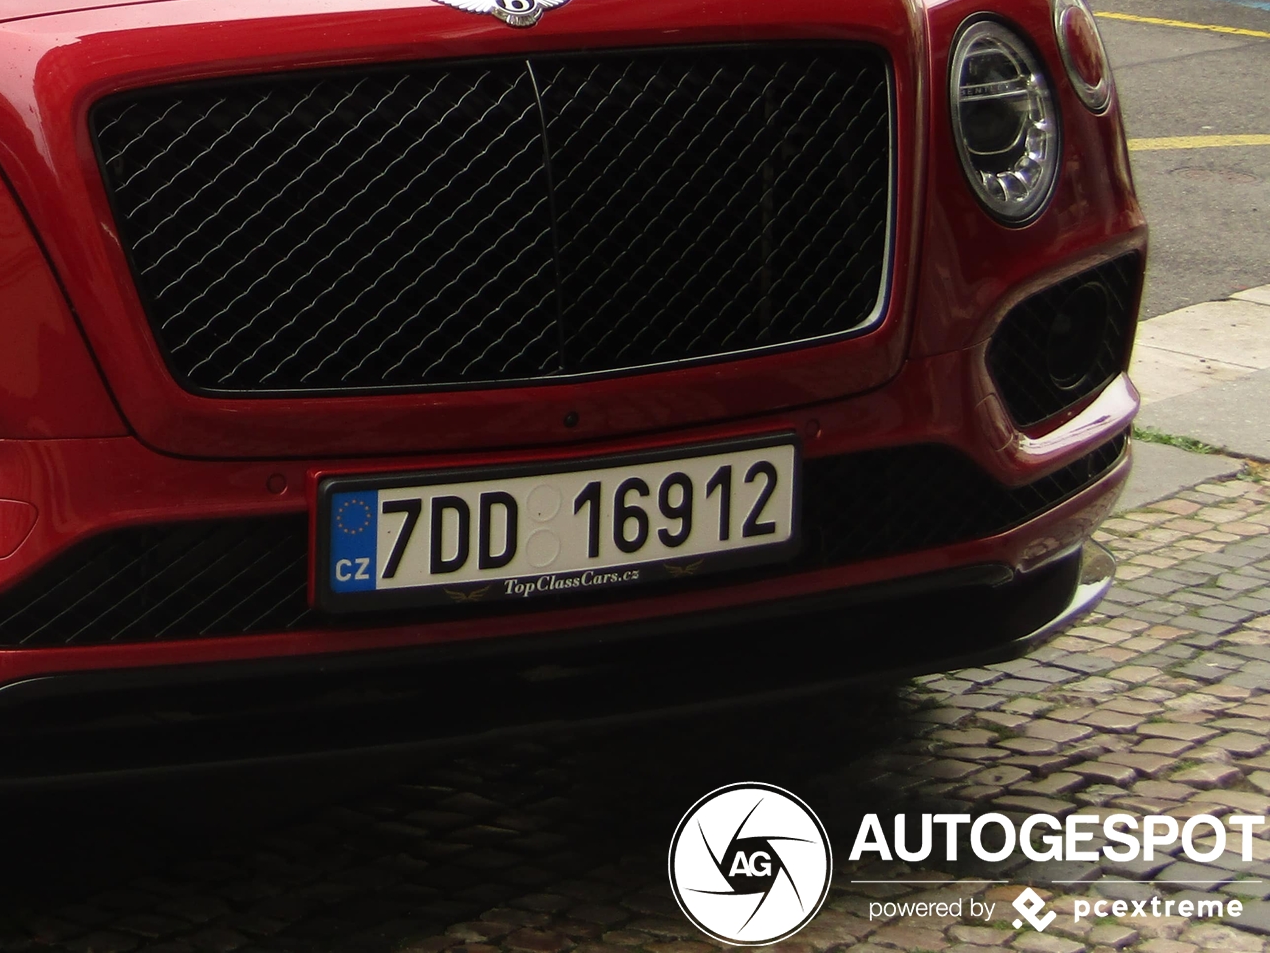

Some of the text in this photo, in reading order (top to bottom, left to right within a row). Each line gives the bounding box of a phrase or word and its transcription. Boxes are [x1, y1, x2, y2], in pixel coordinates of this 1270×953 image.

[381, 460, 777, 579] 7DD 16912
[335, 557, 370, 582] CZ
[504, 570, 640, 597] TopClassCars.cz
